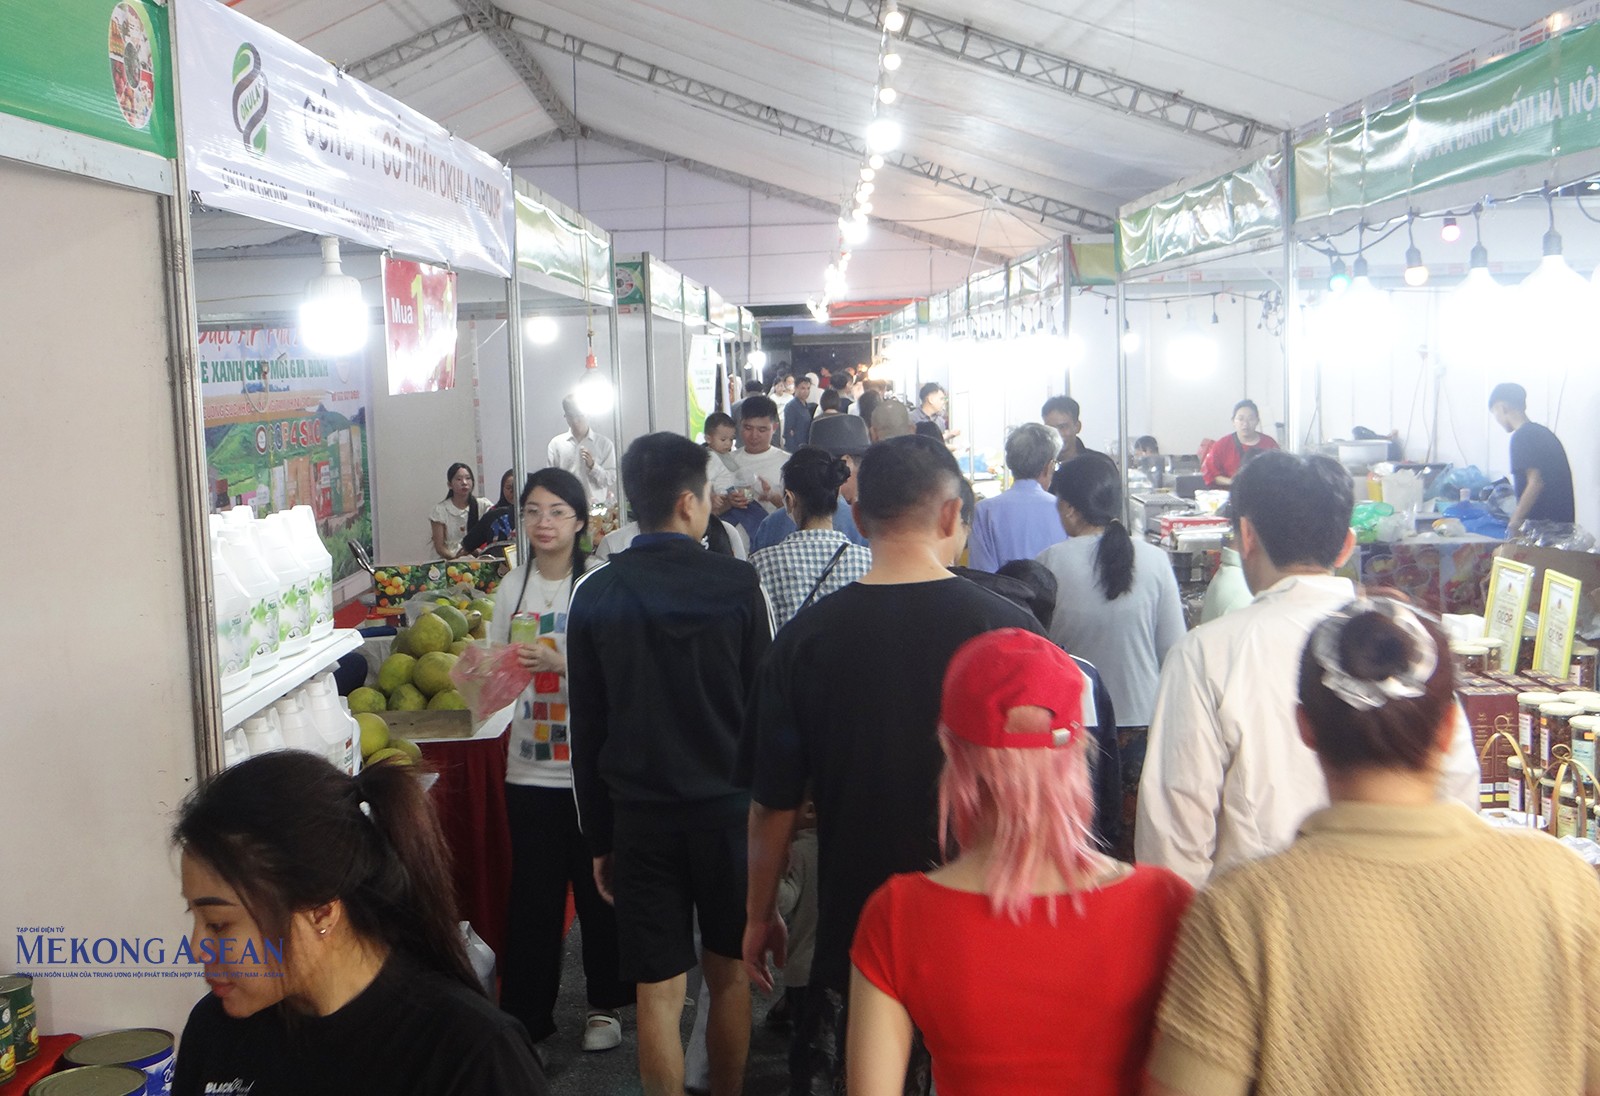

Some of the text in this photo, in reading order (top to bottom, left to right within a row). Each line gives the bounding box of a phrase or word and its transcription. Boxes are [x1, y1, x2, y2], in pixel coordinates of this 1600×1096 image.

[240, 83, 261, 121] OKULA
[1497, 85, 1535, 138] CỐM
[1539, 77, 1563, 125] HÀ
[439, 160, 473, 208] OKULA
[474, 176, 501, 219] GROUP
[391, 297, 414, 324] Mua
[410, 274, 425, 341] 1
[211, 361, 243, 383] XANH
[245, 359, 266, 381] CH
[290, 421, 299, 445] 4
